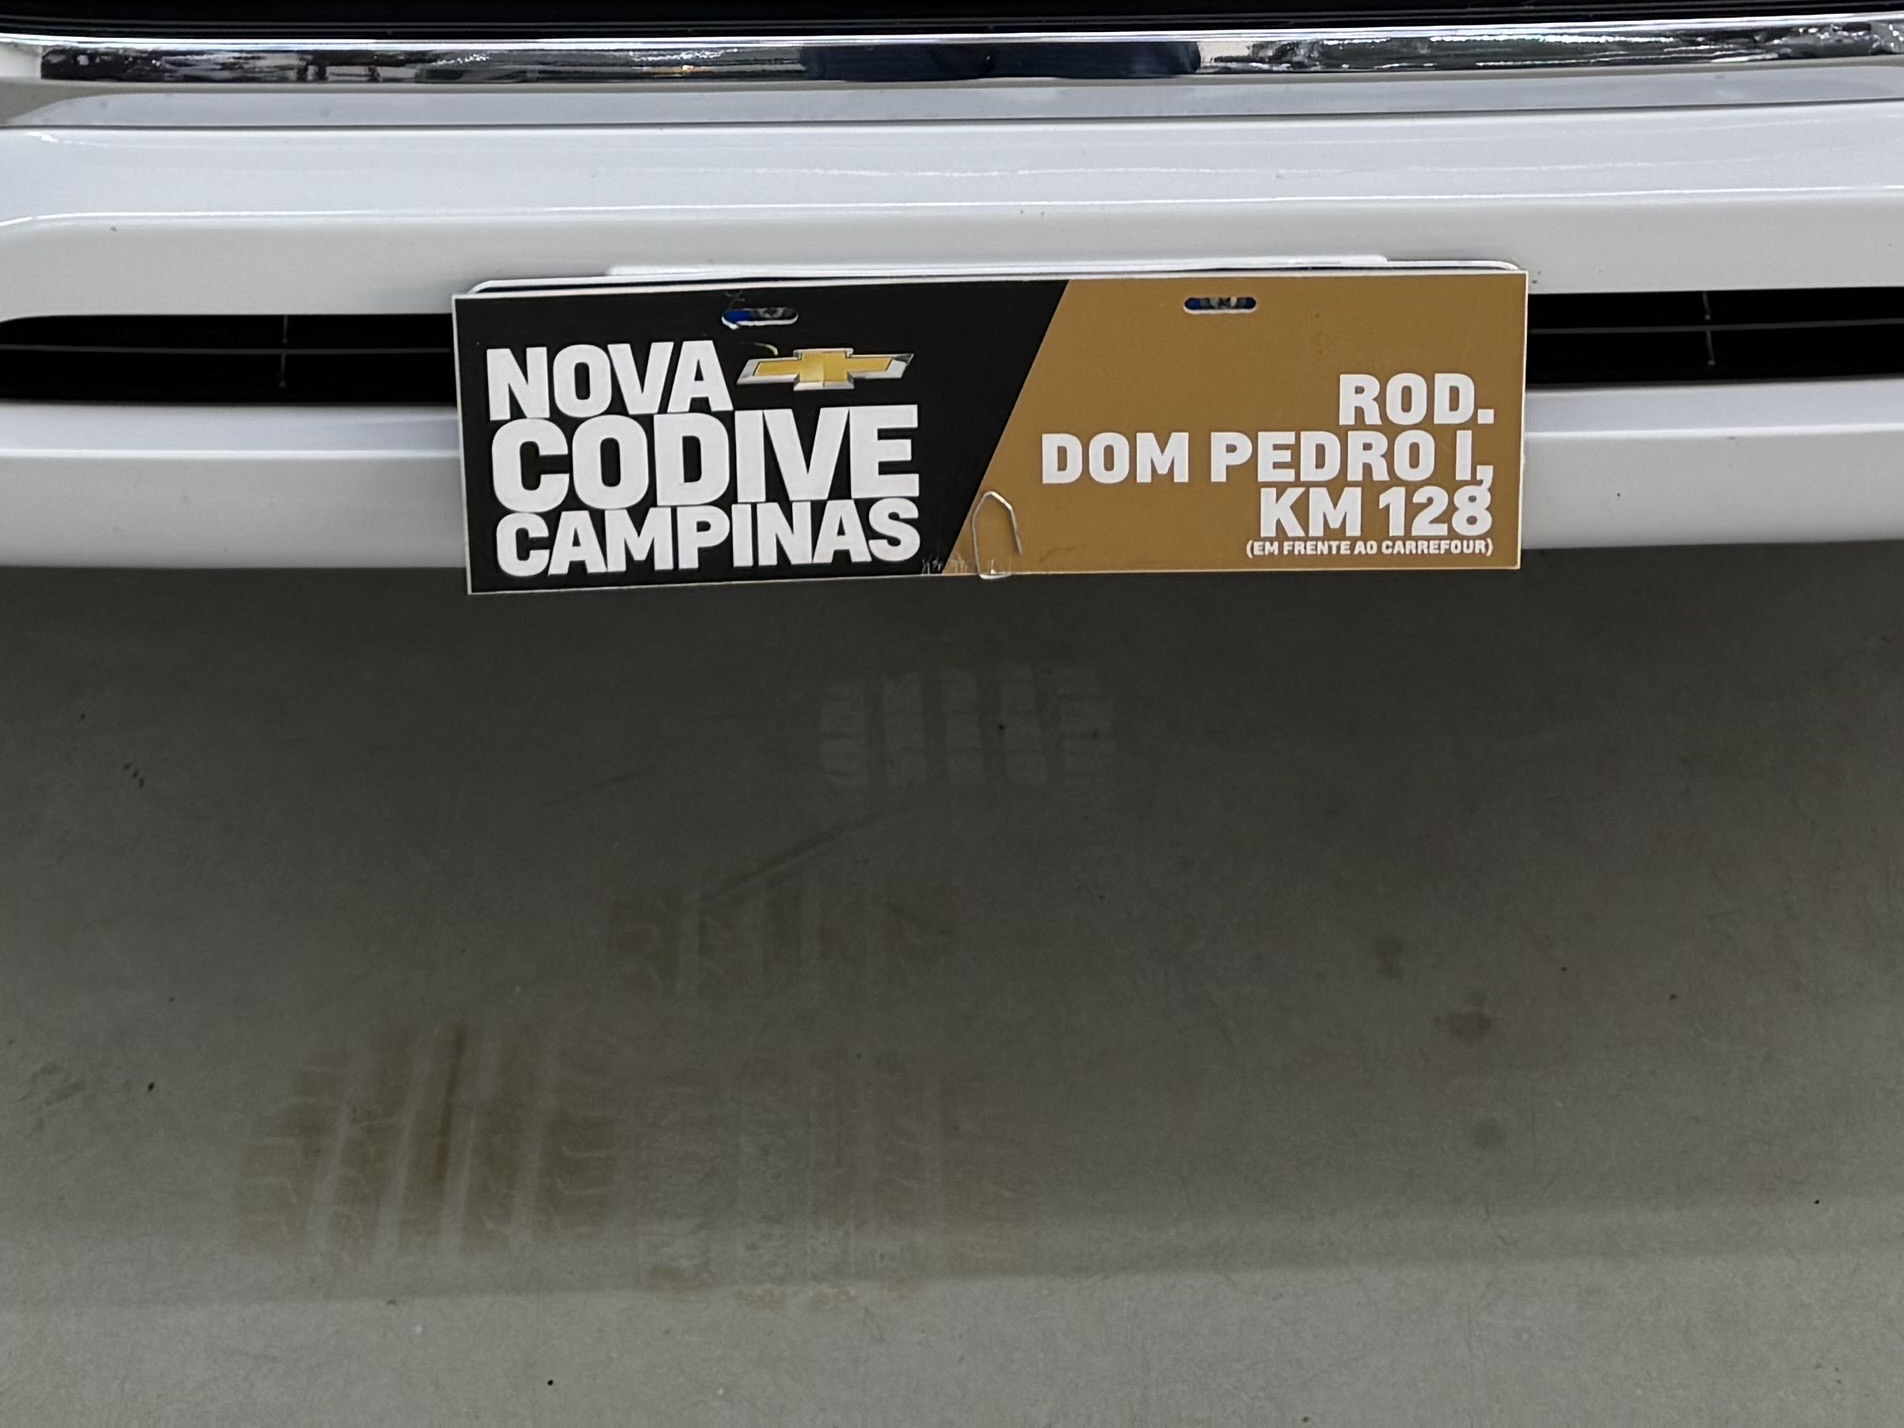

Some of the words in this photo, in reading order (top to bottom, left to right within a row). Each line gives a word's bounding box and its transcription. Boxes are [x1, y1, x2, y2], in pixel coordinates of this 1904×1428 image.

[486, 340, 733, 421] NOVA
[1338, 372, 1495, 426] ROD.
[491, 404, 919, 512] CODIVE
[1041, 431, 1190, 485] DOM
[1210, 430, 1435, 484] PEDRO
[1455, 429, 1494, 490] I,
[496, 497, 921, 577] CAMPINAS
[1259, 486, 1362, 538] KM
[1378, 485, 1493, 537] 128
[1245, 539, 1279, 559] (EM
[1282, 540, 1351, 556] FRENTE
[1353, 540, 1377, 556] AO
[1381, 538, 1494, 557] CARREFOUR)
